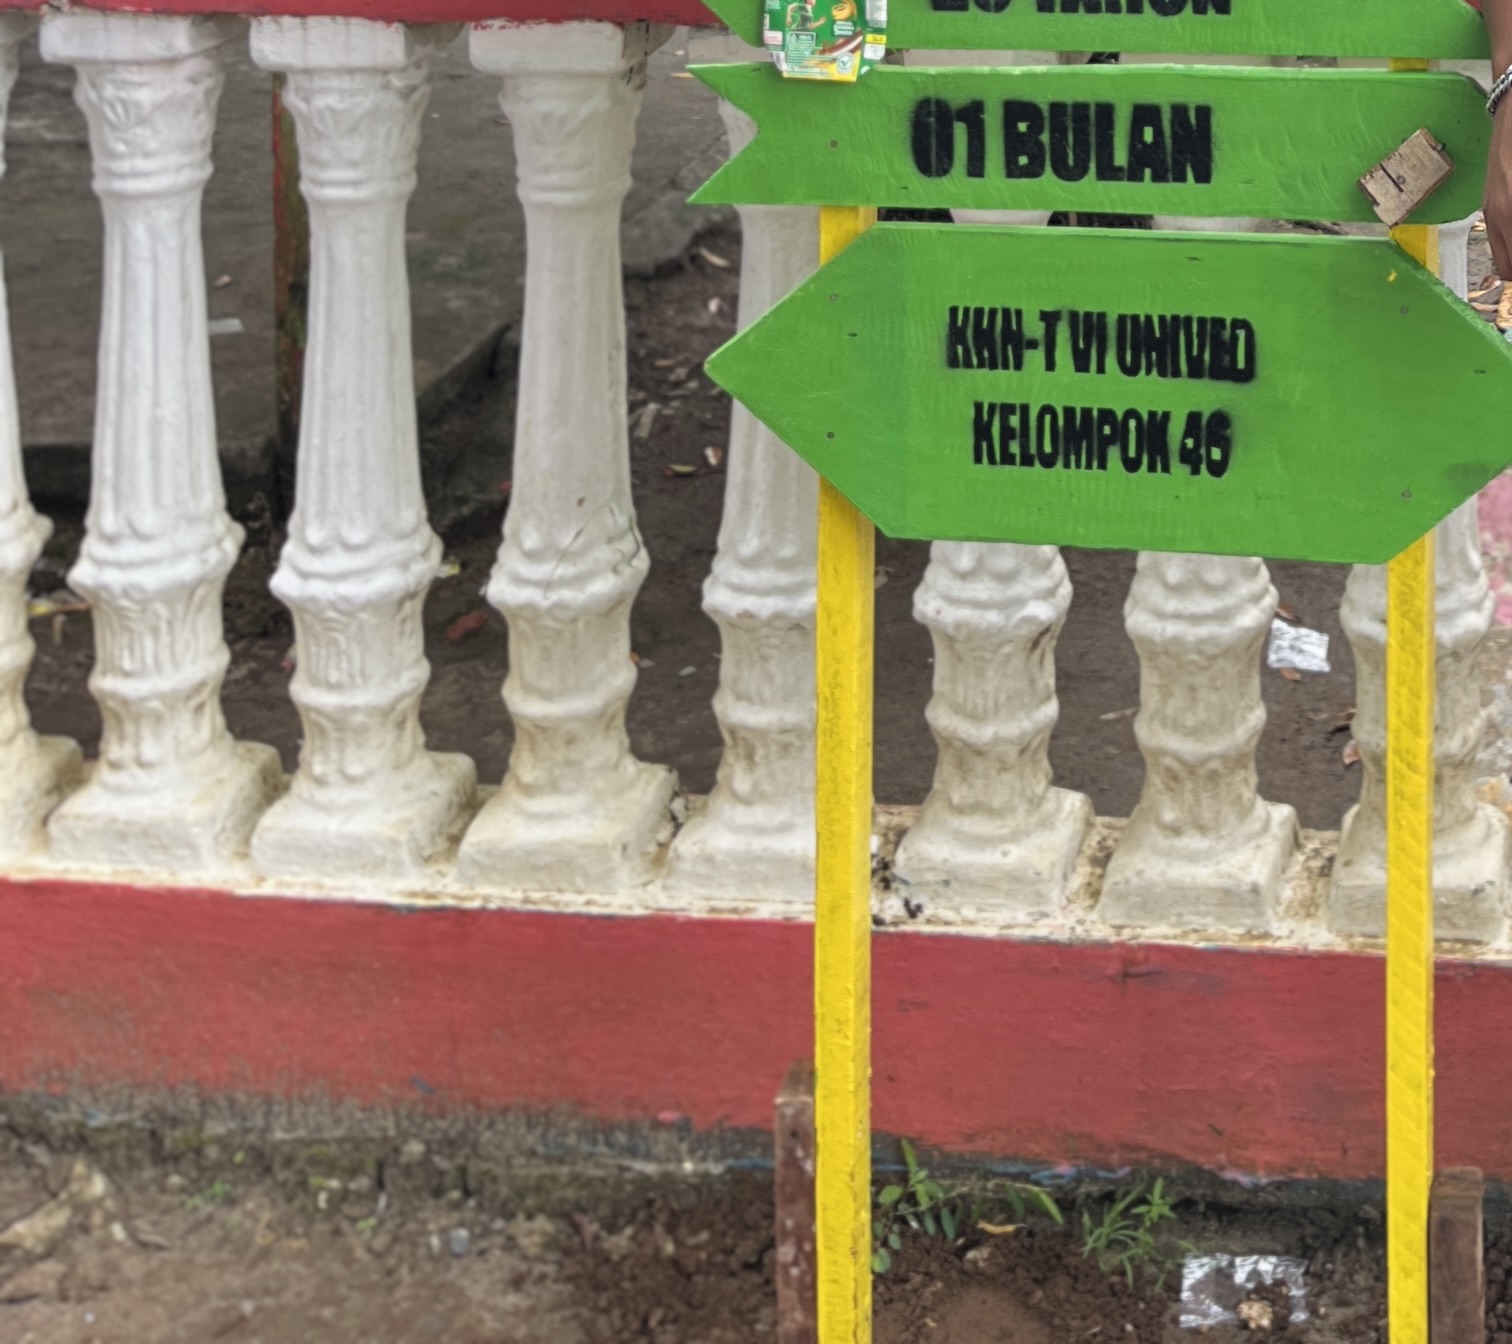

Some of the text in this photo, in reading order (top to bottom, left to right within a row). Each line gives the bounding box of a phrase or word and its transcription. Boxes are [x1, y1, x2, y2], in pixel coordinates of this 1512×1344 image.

[911, 97, 1213, 184] 01 BULAN
[1116, 314, 1256, 382] UNIVED
[973, 401, 1232, 478] KELOMPOK 46
